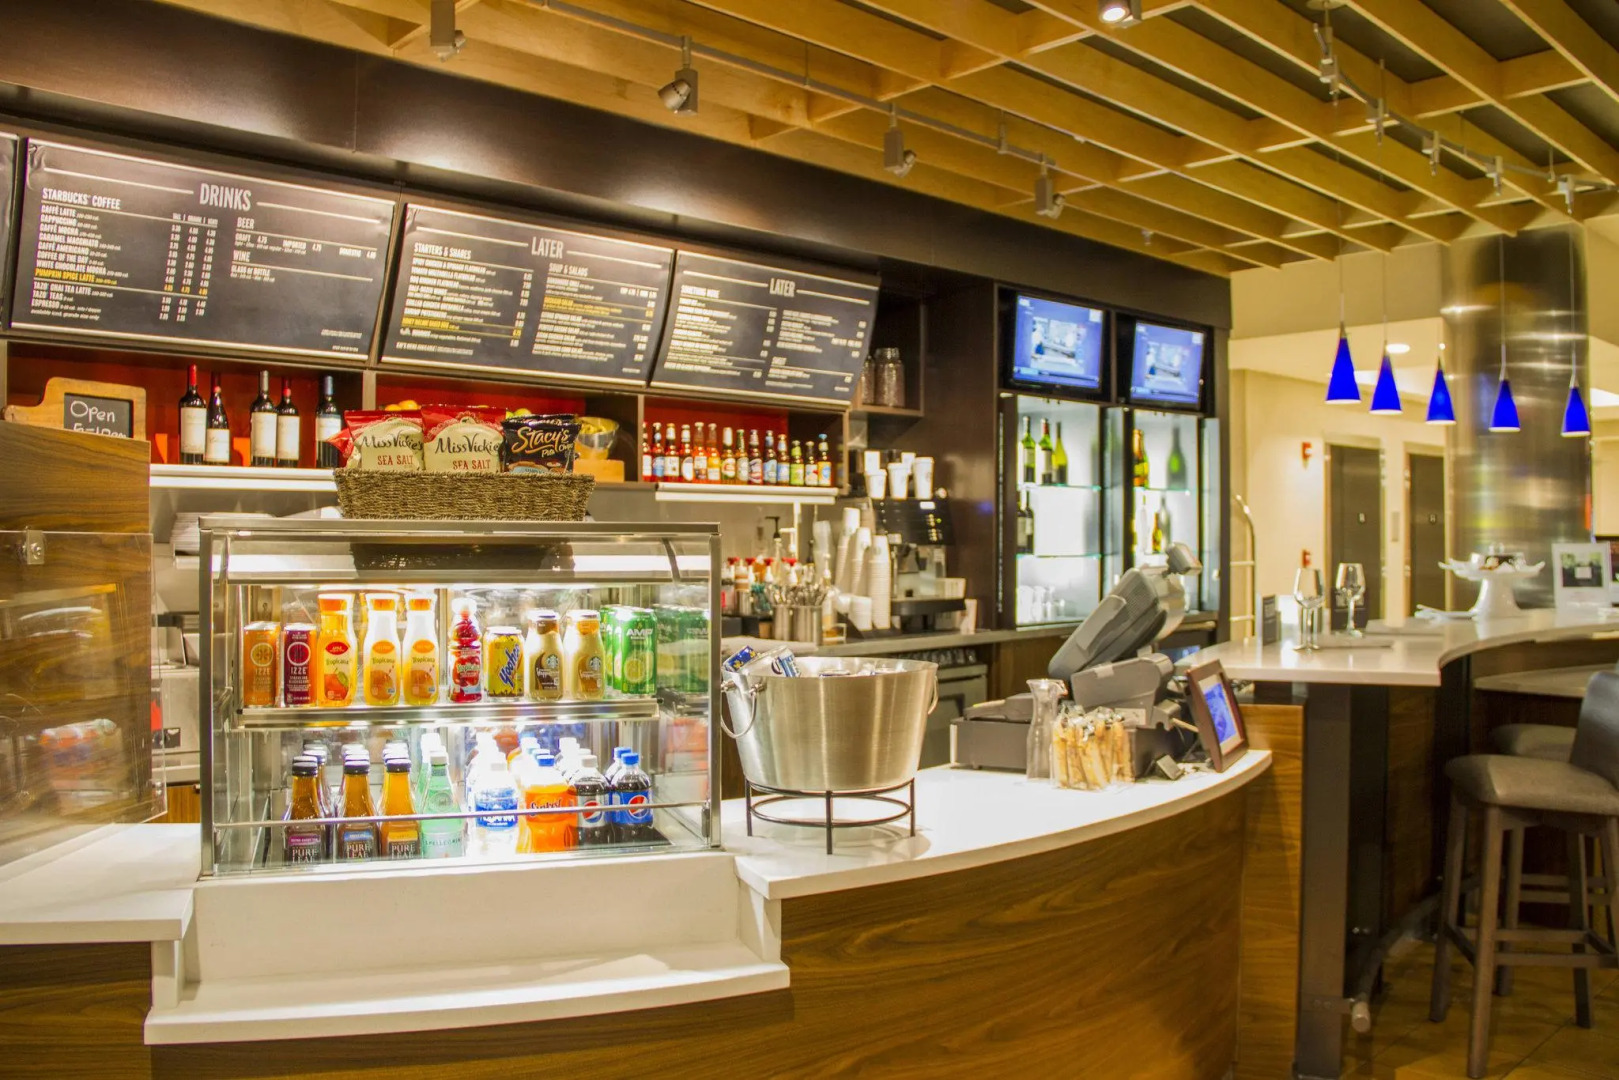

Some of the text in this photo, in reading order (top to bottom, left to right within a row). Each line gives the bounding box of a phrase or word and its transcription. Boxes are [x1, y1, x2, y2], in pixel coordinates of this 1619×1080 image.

[42, 187, 121, 210] STARBUCKS COFFEE
[200, 183, 251, 212] DRINKS
[60, 208, 77, 217] LATTE
[237, 217, 255, 230] BEER
[414, 242, 443, 256] STARTERS
[531, 236, 564, 259] LATER
[233, 249, 251, 263] WINE
[769, 278, 796, 298] LATER
[70, 400, 115, 423] Open
[435, 433, 499, 456] Miss Vickie
[511, 426, 570, 453] Stacy's
[377, 454, 413, 465] SEA SALT
[453, 460, 490, 470] SEA SALT
[291, 667, 307, 675] IZZE
[347, 843, 371, 852] PURE
[392, 844, 415, 852] PURE
